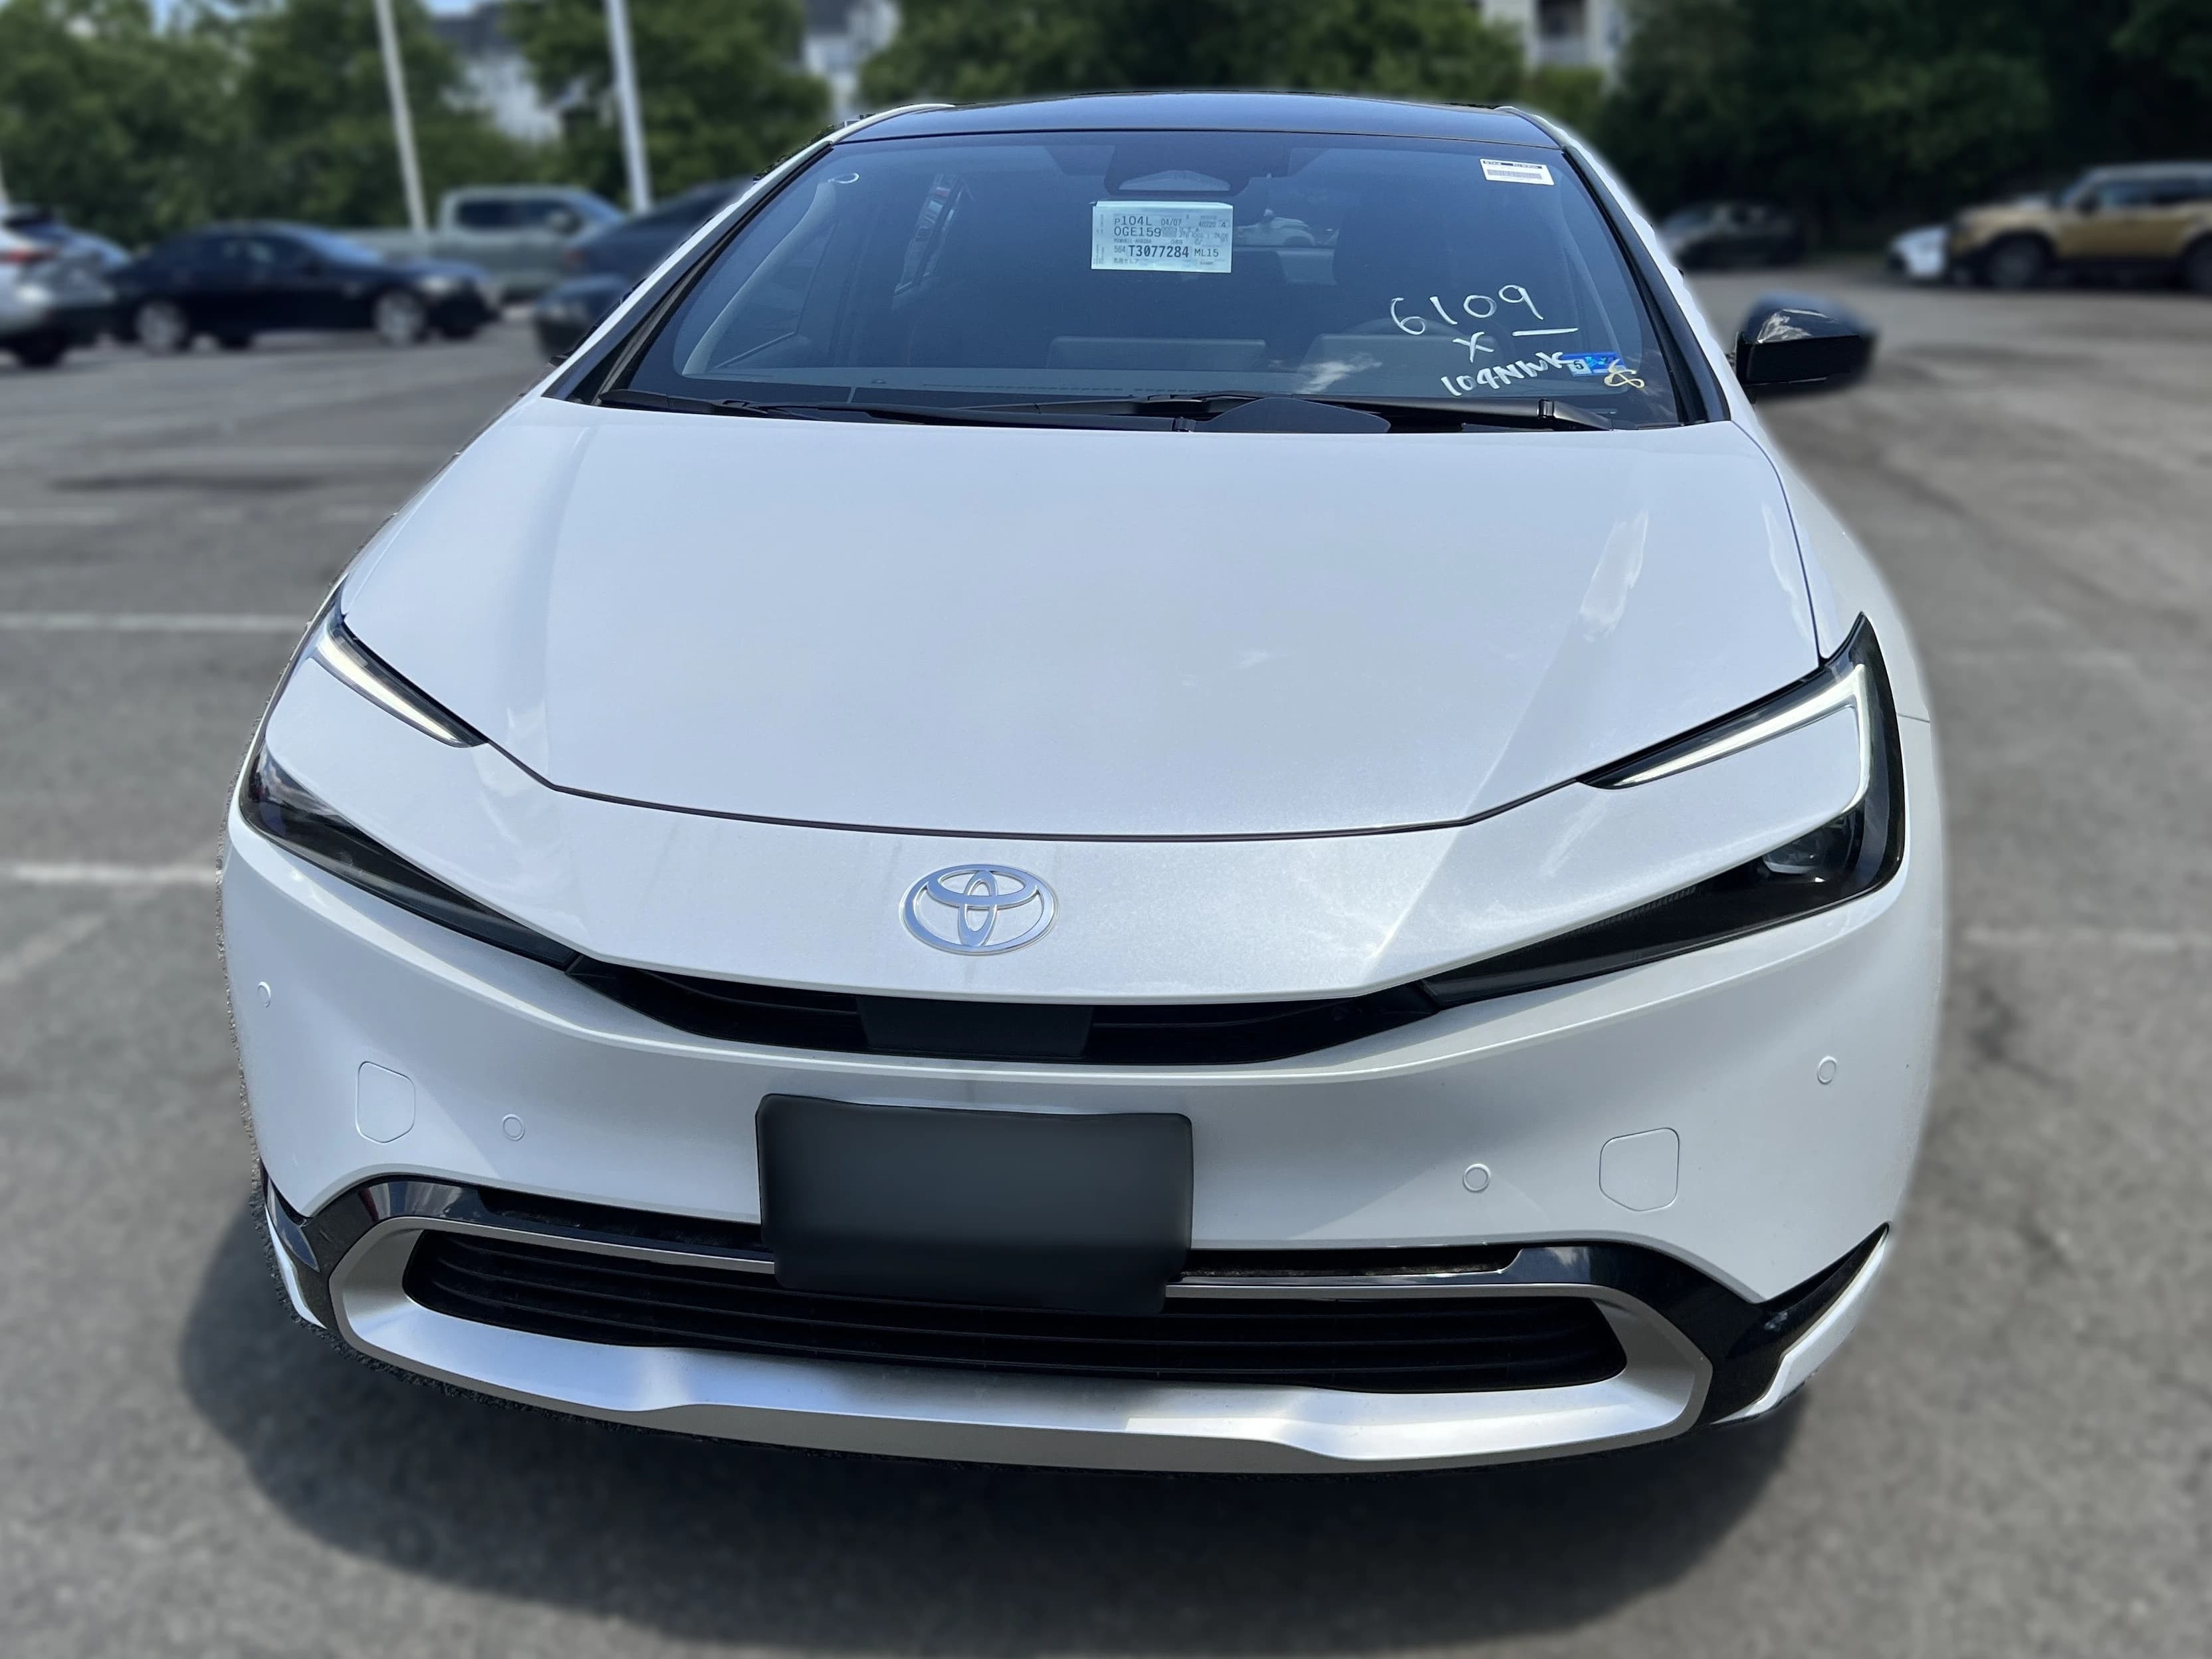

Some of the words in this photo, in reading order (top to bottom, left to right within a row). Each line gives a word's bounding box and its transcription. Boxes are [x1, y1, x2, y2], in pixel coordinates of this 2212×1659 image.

[1128, 245, 1188, 258] T3077284
[1194, 248, 1219, 257] ML15
[1390, 284, 1545, 336] 6109
